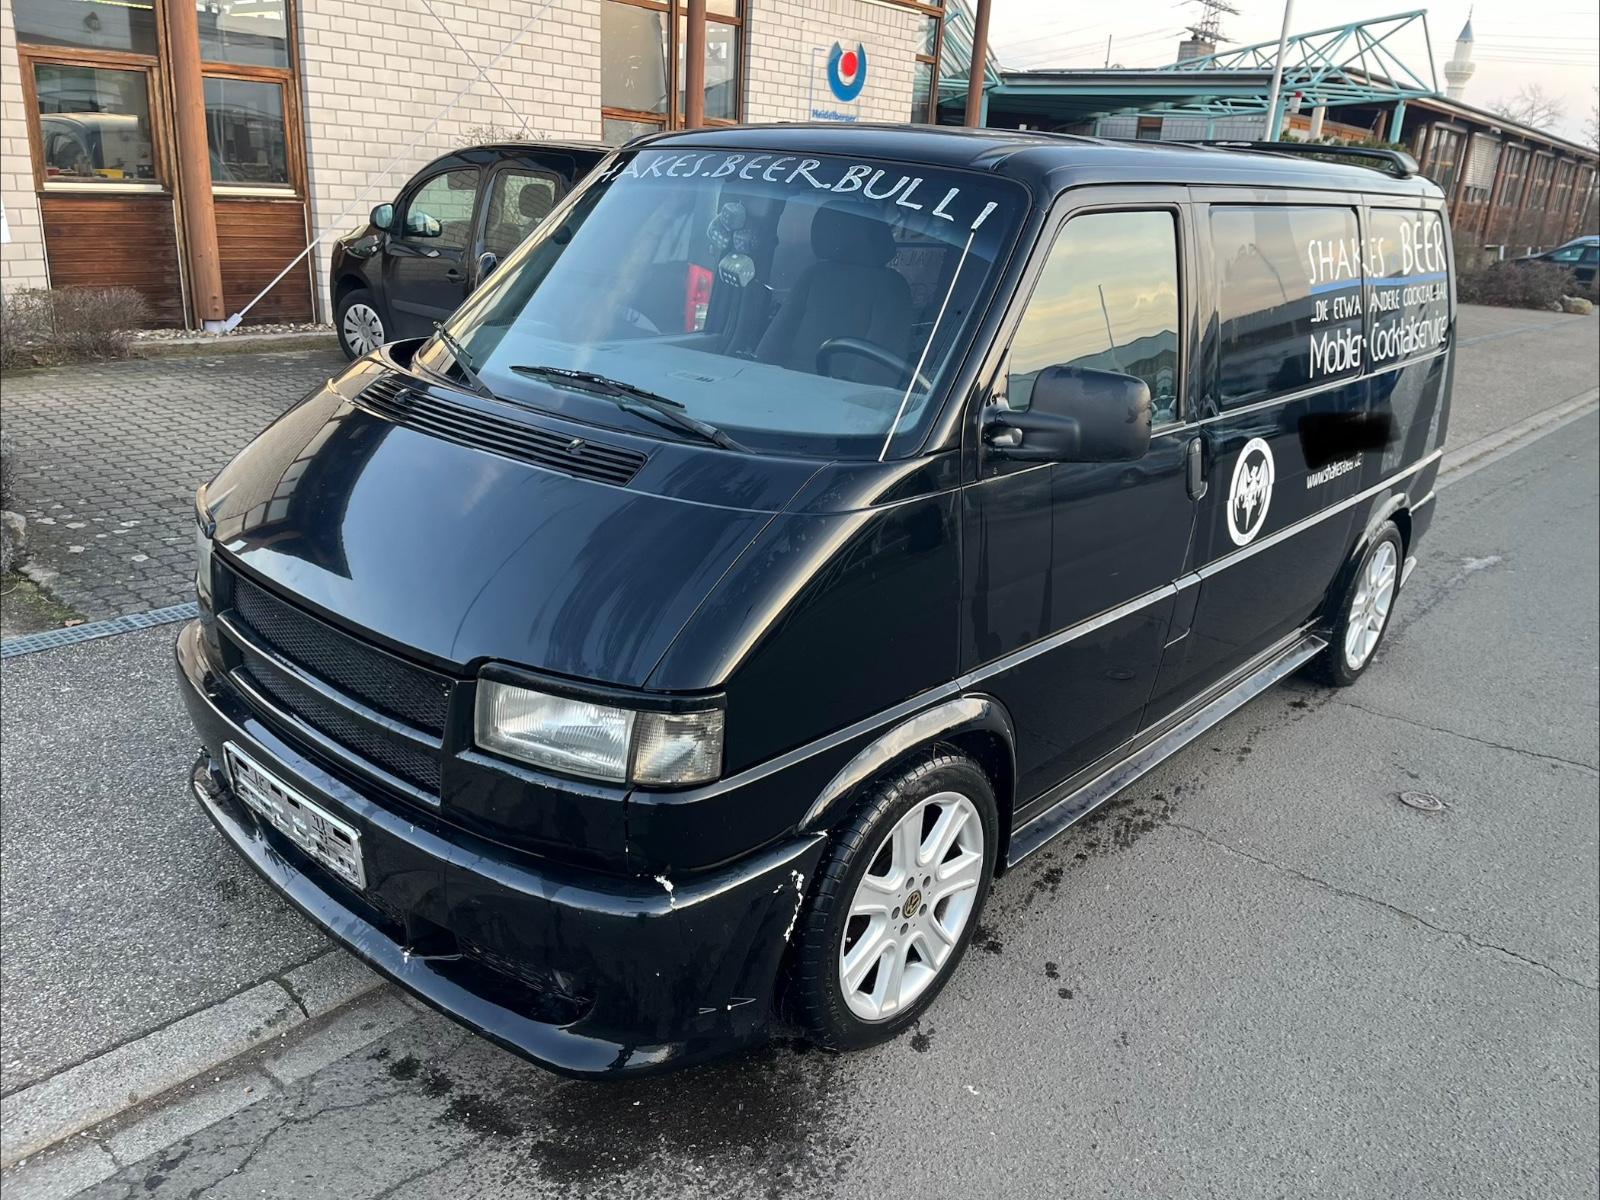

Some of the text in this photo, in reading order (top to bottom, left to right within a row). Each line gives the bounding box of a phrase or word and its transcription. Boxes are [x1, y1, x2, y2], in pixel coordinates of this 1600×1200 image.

[811, 108, 857, 123] Heidelberger
[1308, 221, 1447, 284] SHAKES BEER
[1333, 294, 1362, 320] ETWA
[1369, 288, 1400, 312] ANDERE
